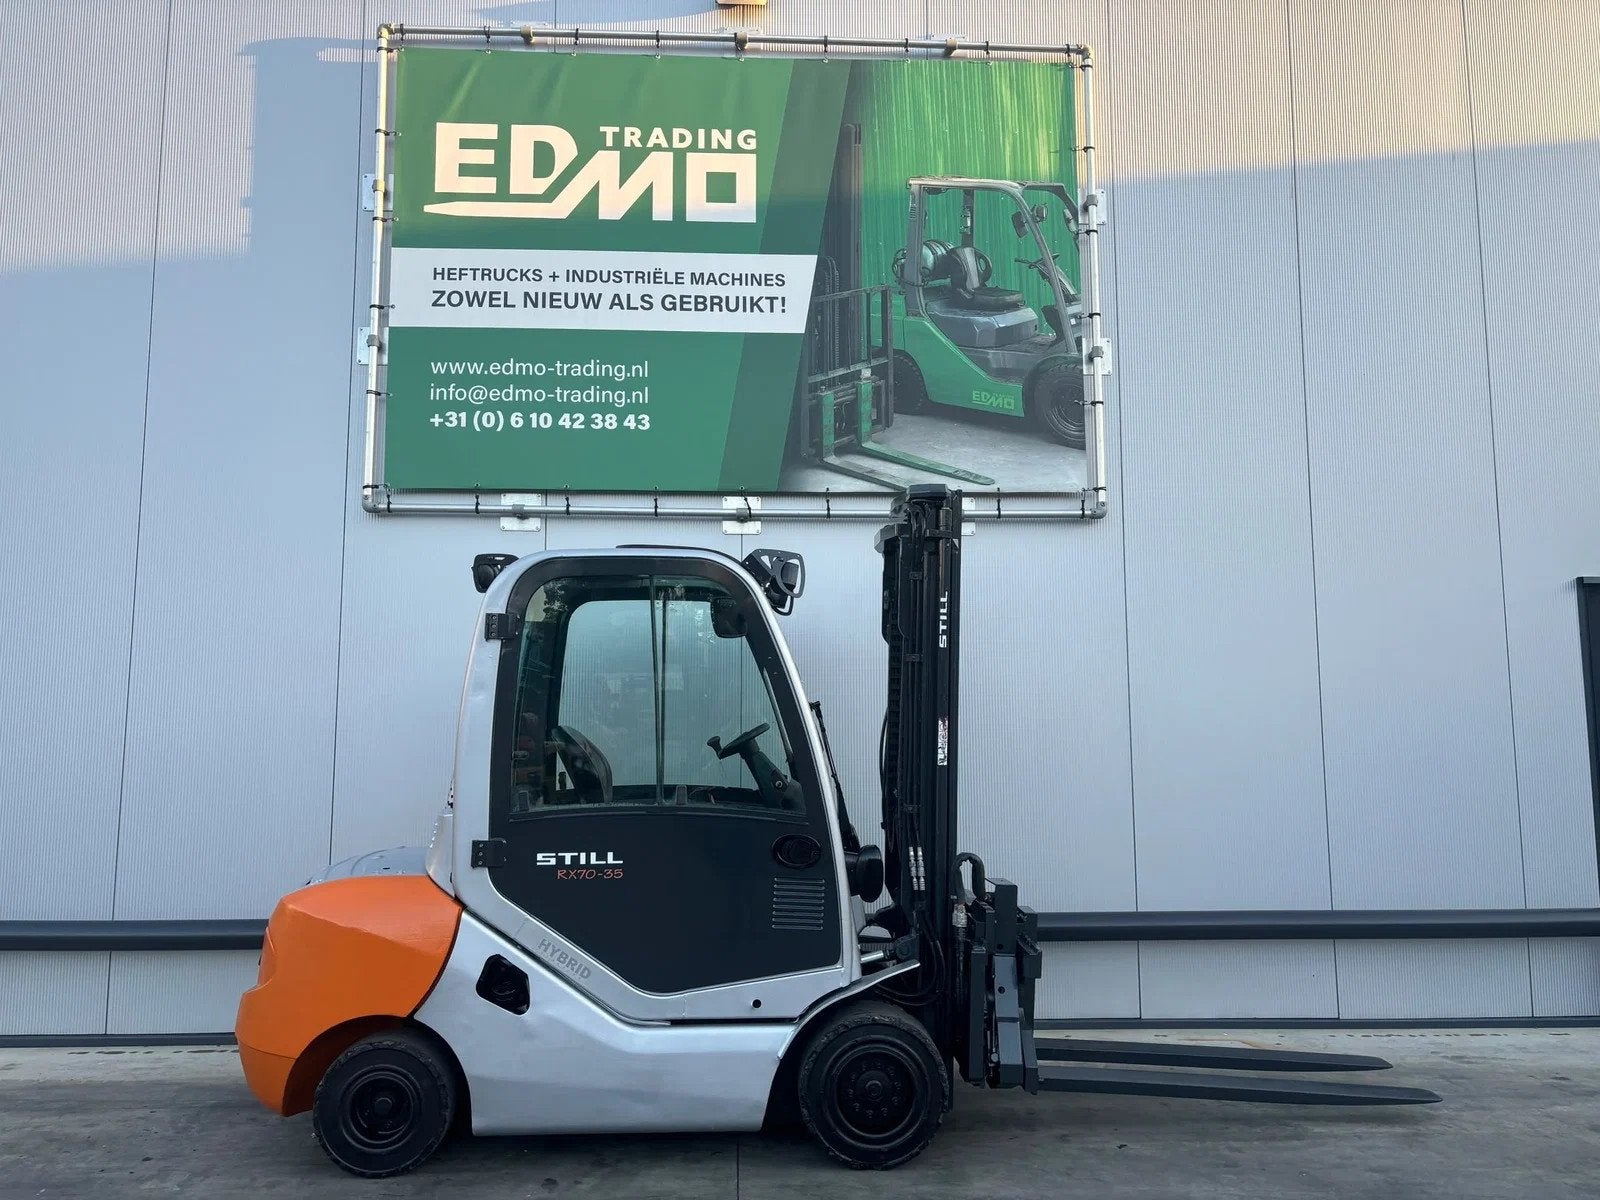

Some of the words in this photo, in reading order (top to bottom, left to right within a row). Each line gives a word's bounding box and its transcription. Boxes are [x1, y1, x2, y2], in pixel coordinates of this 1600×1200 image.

[600, 125, 758, 151] TRADING
[424, 122, 757, 223] EDMO
[433, 267, 543, 283] HEFTRUCKS
[548, 271, 561, 283] +
[566, 267, 685, 286] INDUSTRIËLE
[690, 271, 786, 288] MACHINES
[431, 290, 516, 309] ZOWEL
[523, 291, 603, 310] NIEUW
[609, 293, 655, 312] ALS
[660, 294, 787, 314] GEBRUIKT!
[430, 358, 649, 382] www.edmo-trading.nl
[429, 383, 649, 408] info@edmo-trading.nl
[971, 390, 1015, 410] EDMO
[429, 411, 467, 428] +31
[473, 410, 504, 432] (0)
[510, 412, 524, 429] 6
[529, 412, 553, 429] 10
[558, 412, 586, 430] 42
[590, 413, 618, 430] 38
[623, 413, 651, 431] 43
[938, 591, 948, 648] STILL
[536, 852, 624, 865] STILL
[556, 868, 624, 880] RX70-35
[538, 938, 592, 980] HYBRID
